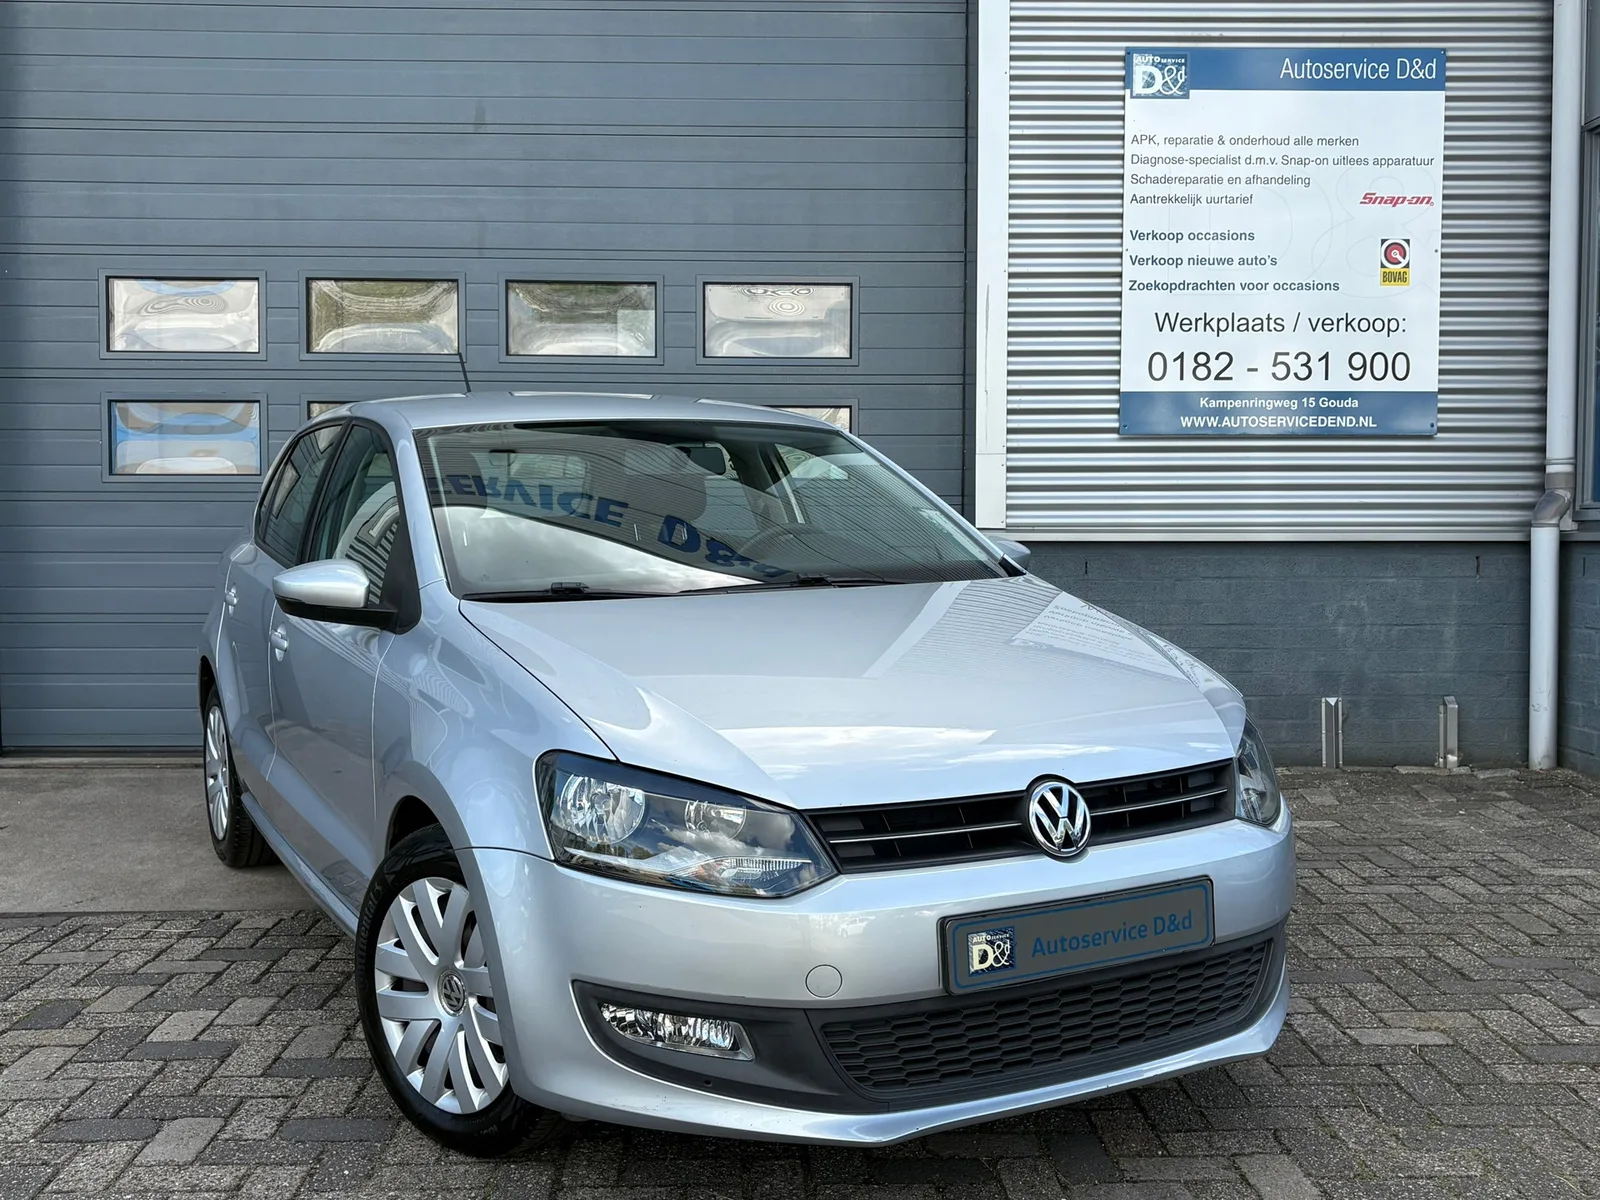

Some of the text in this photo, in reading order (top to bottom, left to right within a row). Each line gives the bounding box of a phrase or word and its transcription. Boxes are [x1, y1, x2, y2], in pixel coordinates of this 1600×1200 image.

[1279, 57, 1437, 80] Autoservice D&d
[1130, 133, 1360, 148] APK, reparatie & onderhoud alle merken
[1130, 153, 1435, 169] Diagnose-specialist d.m.v. Snap-on uitlees apparatuur
[1130, 173, 1311, 188] Schadereparatie en afhandeling
[1129, 193, 1254, 207] Aantrekkelijk uurtarief
[1129, 229, 1256, 244] Verkoop occasions
[1129, 254, 1278, 269] Verkoop nieuwe auto's
[1382, 271, 1408, 283] BOVAG
[1128, 279, 1340, 294] Zoekopdrachten voor occasions
[1154, 311, 1407, 339] Werkplaats / verkoop:
[1147, 350, 1234, 382] 0182
[1270, 350, 1331, 382] 531
[1347, 351, 1411, 382] 900
[1199, 396, 1359, 412] Kampenringweg 15 Gouda
[1180, 414, 1378, 428] WWW.AUTOSERVICEDEND.NL
[1031, 909, 1193, 958] Autoservice D&d
